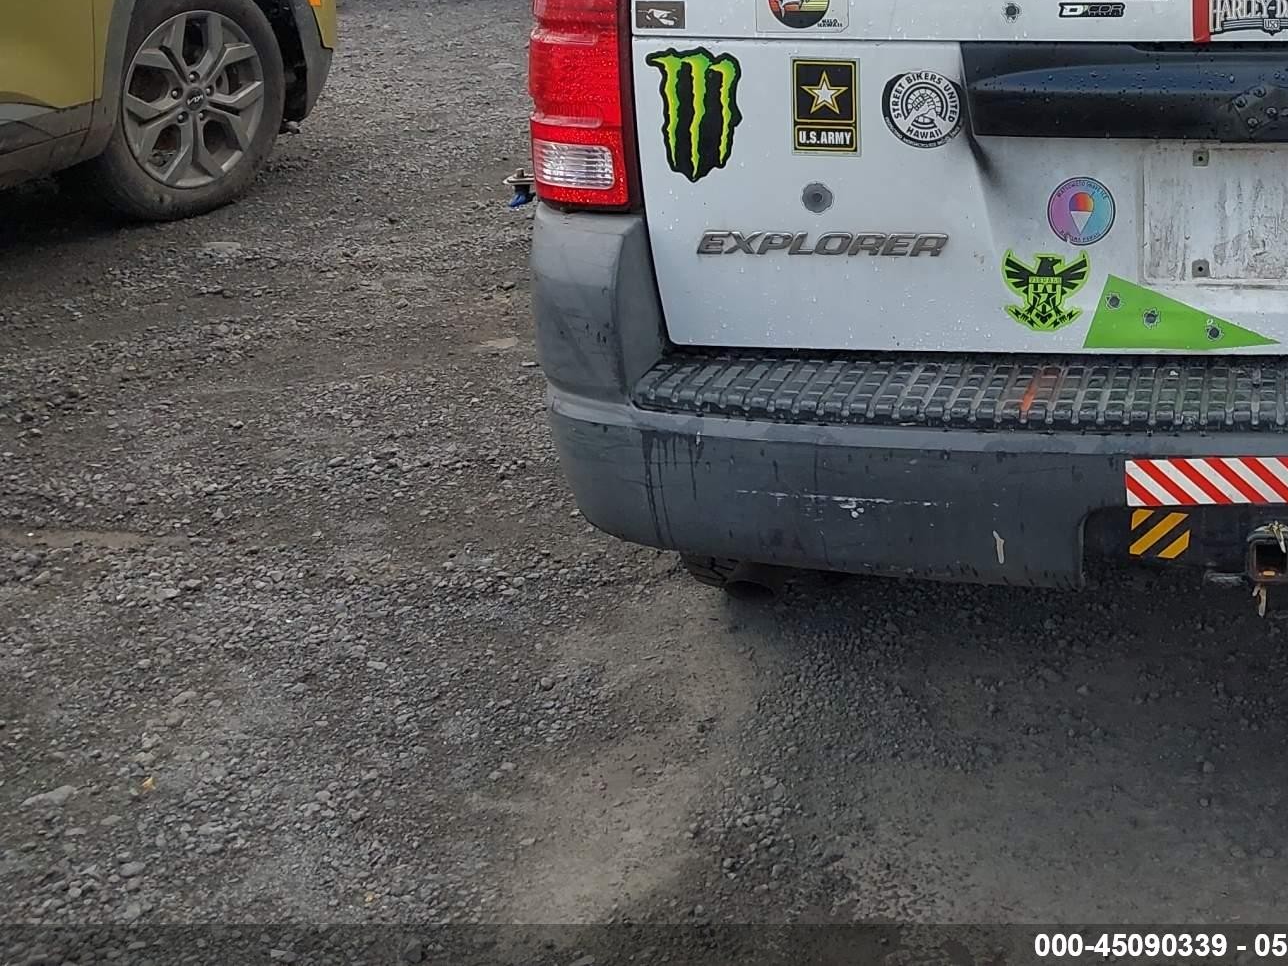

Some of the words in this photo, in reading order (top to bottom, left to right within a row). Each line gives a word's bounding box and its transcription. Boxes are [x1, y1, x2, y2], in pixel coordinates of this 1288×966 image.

[891, 82, 905, 119] STREET
[905, 72, 943, 85] BIKERS
[943, 83, 958, 123] UNITED
[906, 126, 943, 139] HAWAII
[696, 229, 949, 257] EXPLORER
